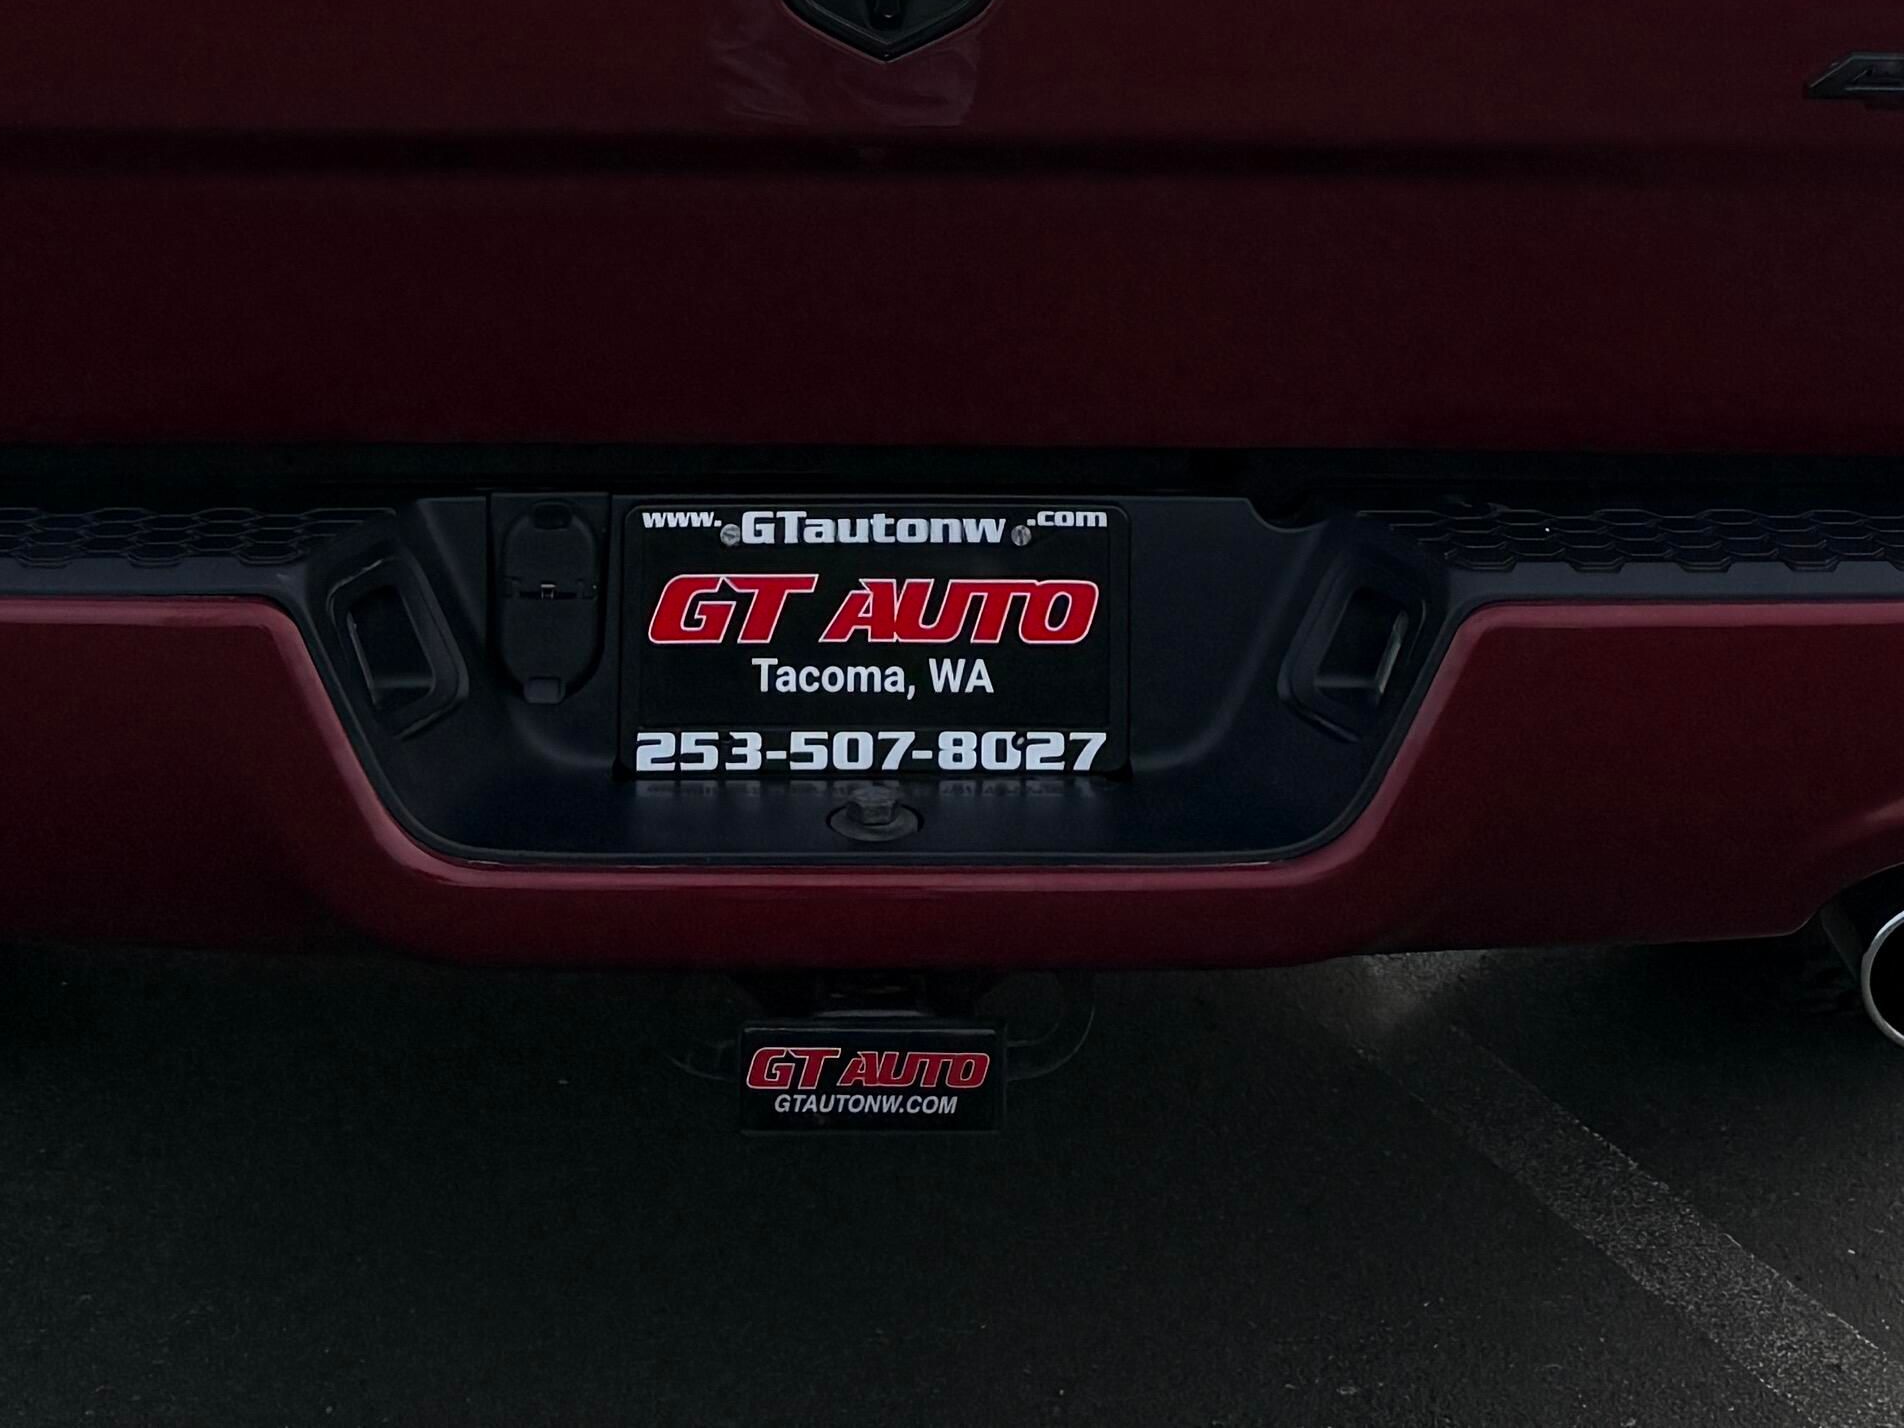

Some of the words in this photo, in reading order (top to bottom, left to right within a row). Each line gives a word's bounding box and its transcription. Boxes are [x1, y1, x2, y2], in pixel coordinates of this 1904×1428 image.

[741, 511, 1007, 544] GTautonw
[648, 573, 819, 644] GT
[818, 578, 1099, 644] AUTO
[751, 657, 915, 700] Tacoma,
[928, 658, 994, 693] WA
[636, 731, 1107, 771] 253-507-8027
[746, 1047, 841, 1089] GT
[836, 1051, 990, 1088] AUTO
[774, 1094, 958, 1114] GTAUTONW.COM
